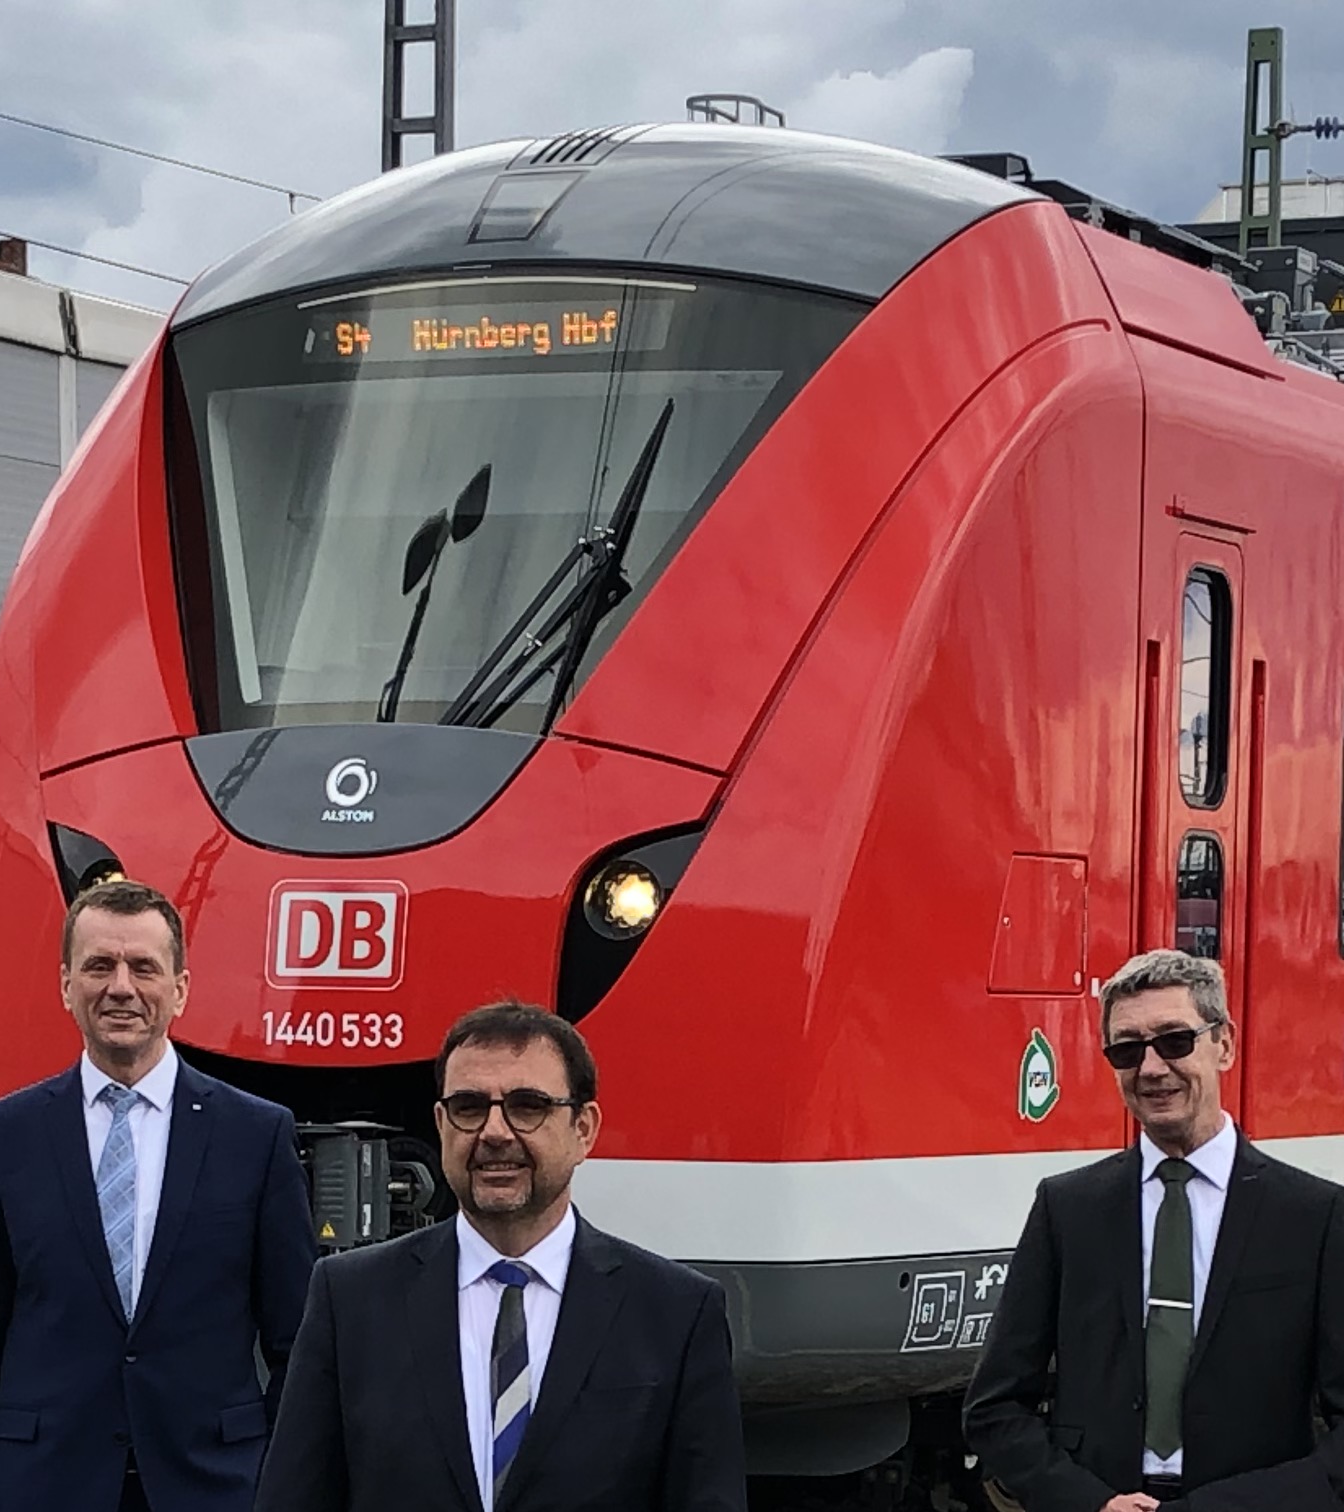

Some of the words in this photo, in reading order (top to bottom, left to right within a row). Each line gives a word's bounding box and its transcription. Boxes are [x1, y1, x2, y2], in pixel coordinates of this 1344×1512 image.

[336, 322, 372, 355] S4
[413, 316, 552, 355] Nürnberg
[562, 310, 618, 345] Hbf
[321, 808, 374, 823] ALSTOM
[285, 899, 386, 970] DB
[262, 1011, 336, 1047] 1440
[341, 1012, 404, 1049] 533
